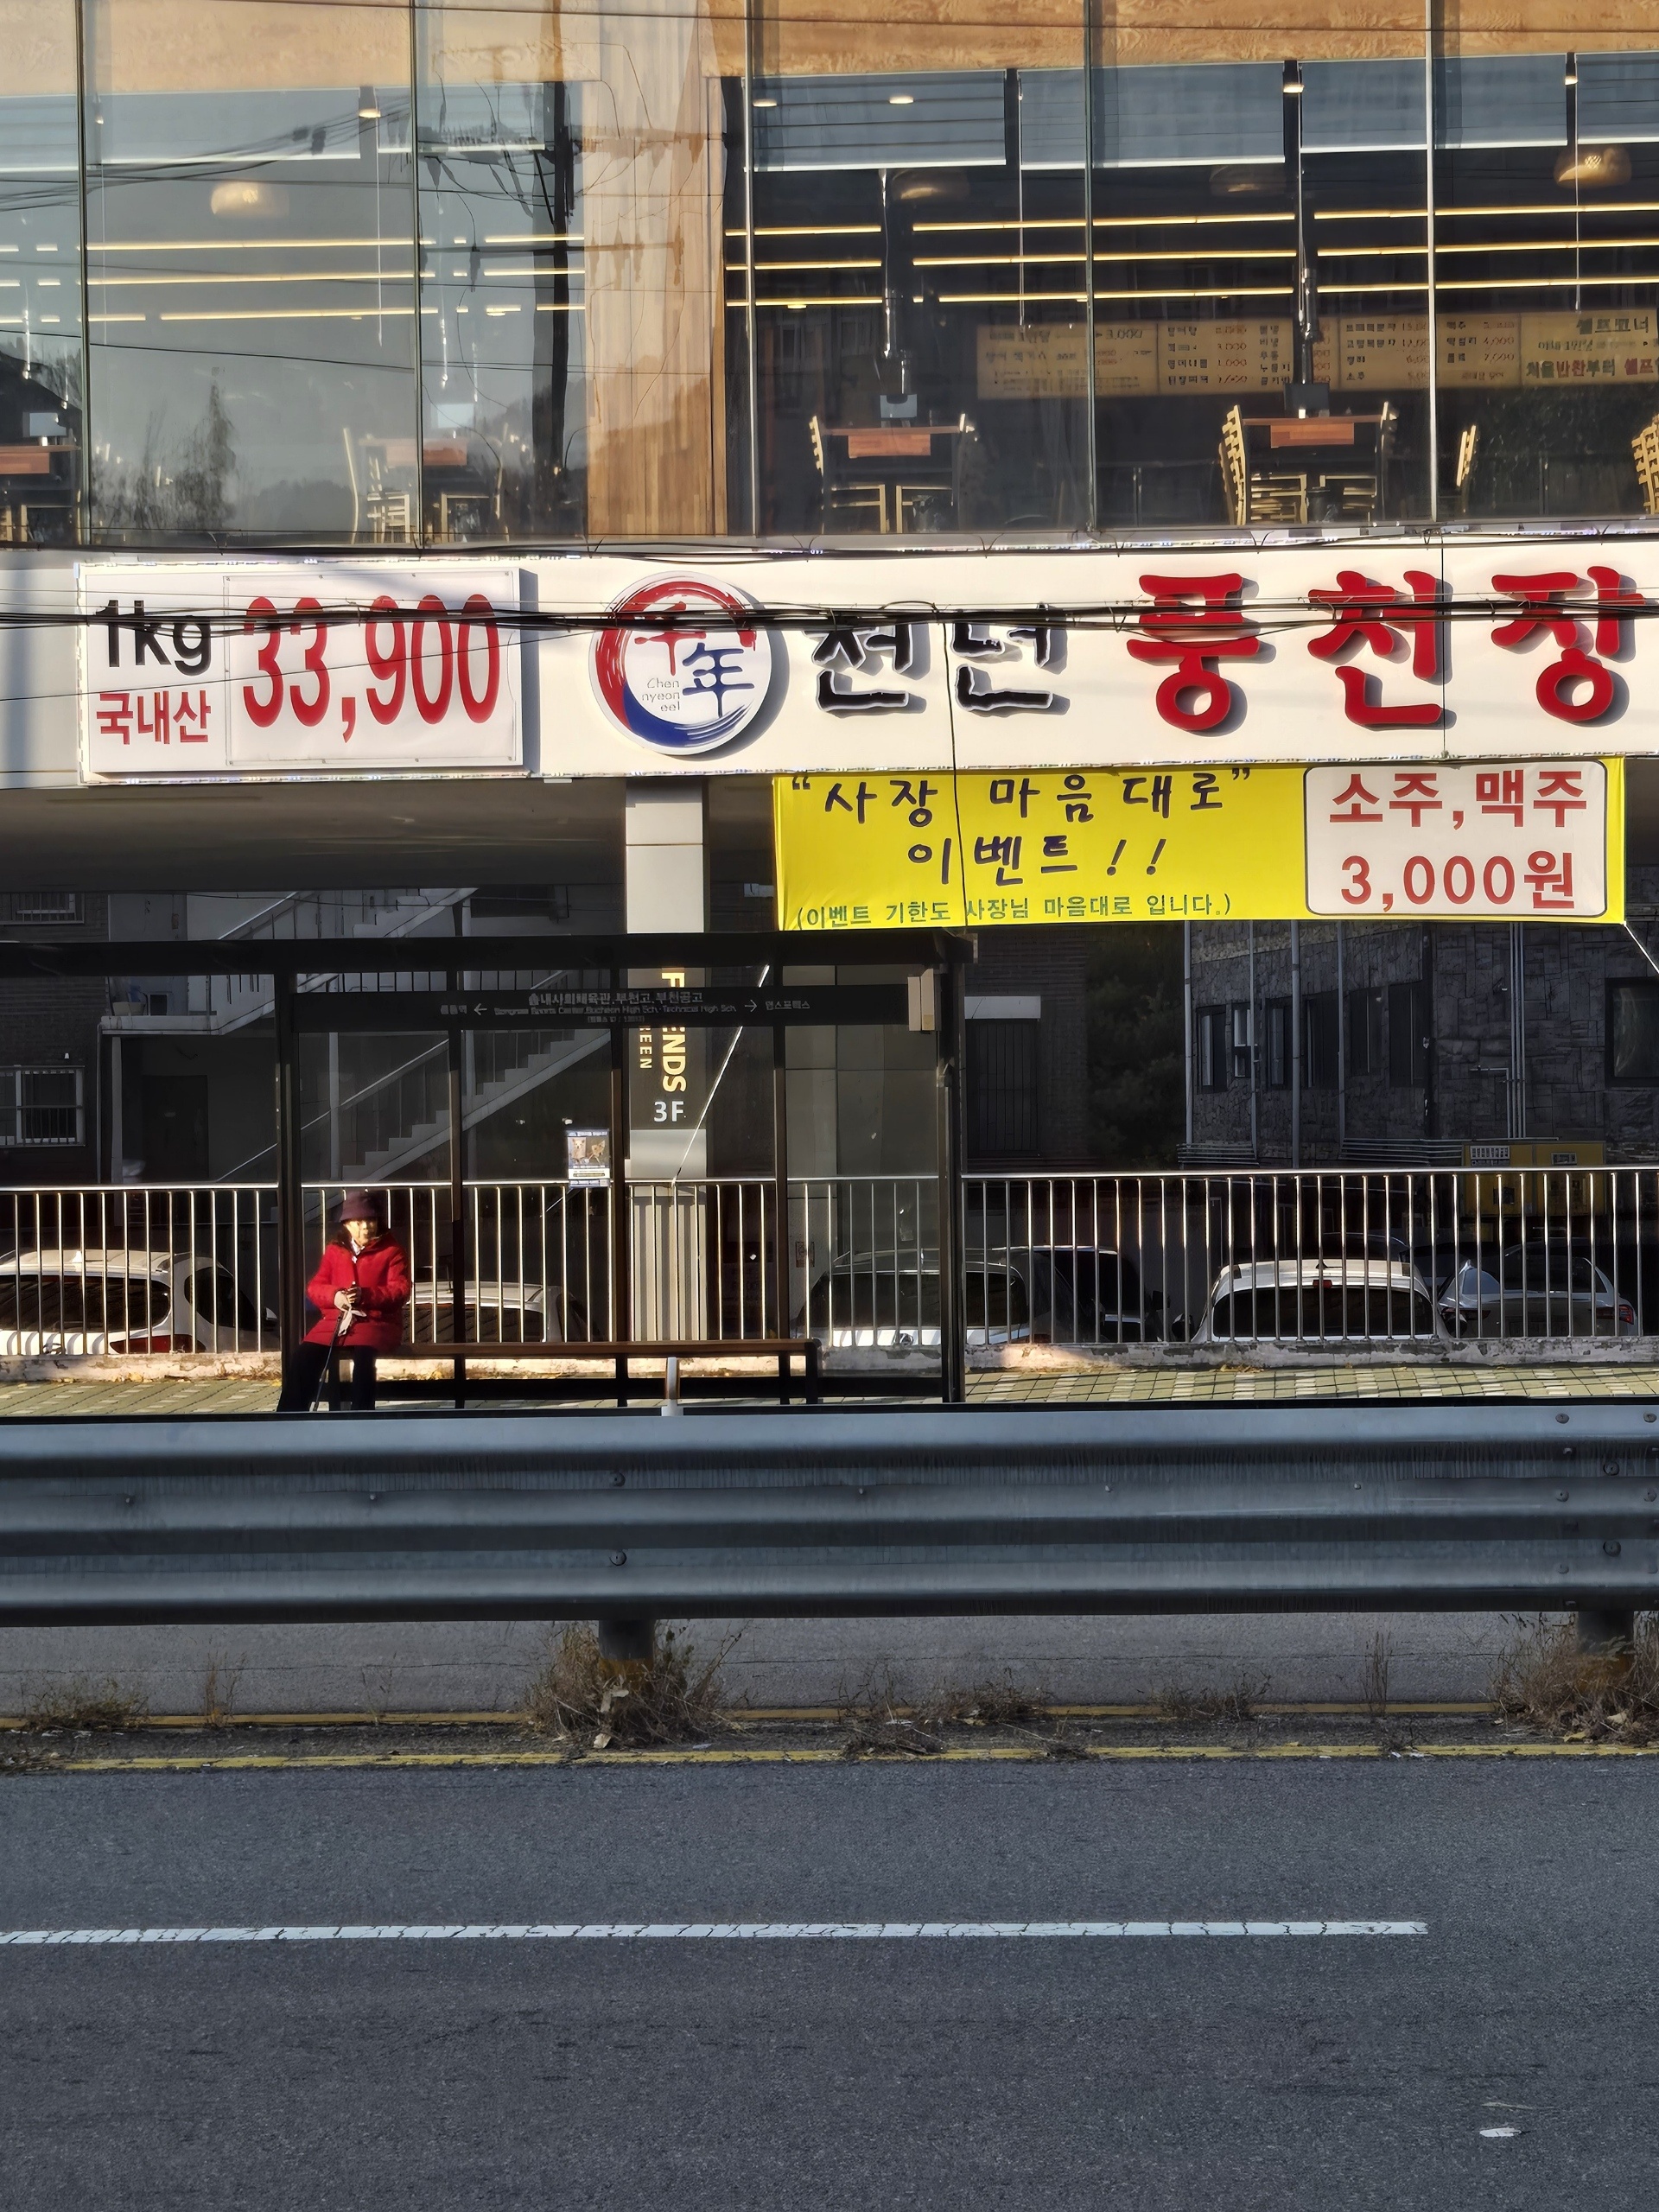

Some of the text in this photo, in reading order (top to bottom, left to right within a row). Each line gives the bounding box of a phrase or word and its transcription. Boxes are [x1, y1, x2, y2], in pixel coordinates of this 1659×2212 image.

[1624, 358, 1659, 375] 셀프
[95, 600, 212, 677] 1kg
[1127, 566, 1646, 731] 풍천장
[243, 594, 500, 745] 33,900
[641, 691, 681, 702] nyeon
[96, 690, 212, 745] 국내산
[660, 702, 681, 712] eel
[1329, 769, 1587, 830] 소주,맥주
[1341, 850, 1575, 912] 3,000원
[797, 906, 872, 930] (이벤트
[886, 901, 951, 924] 기한도
[966, 897, 1029, 920] 사장님
[1044, 895, 1133, 918] 마음대로
[653, 1100, 685, 1122] 3F
